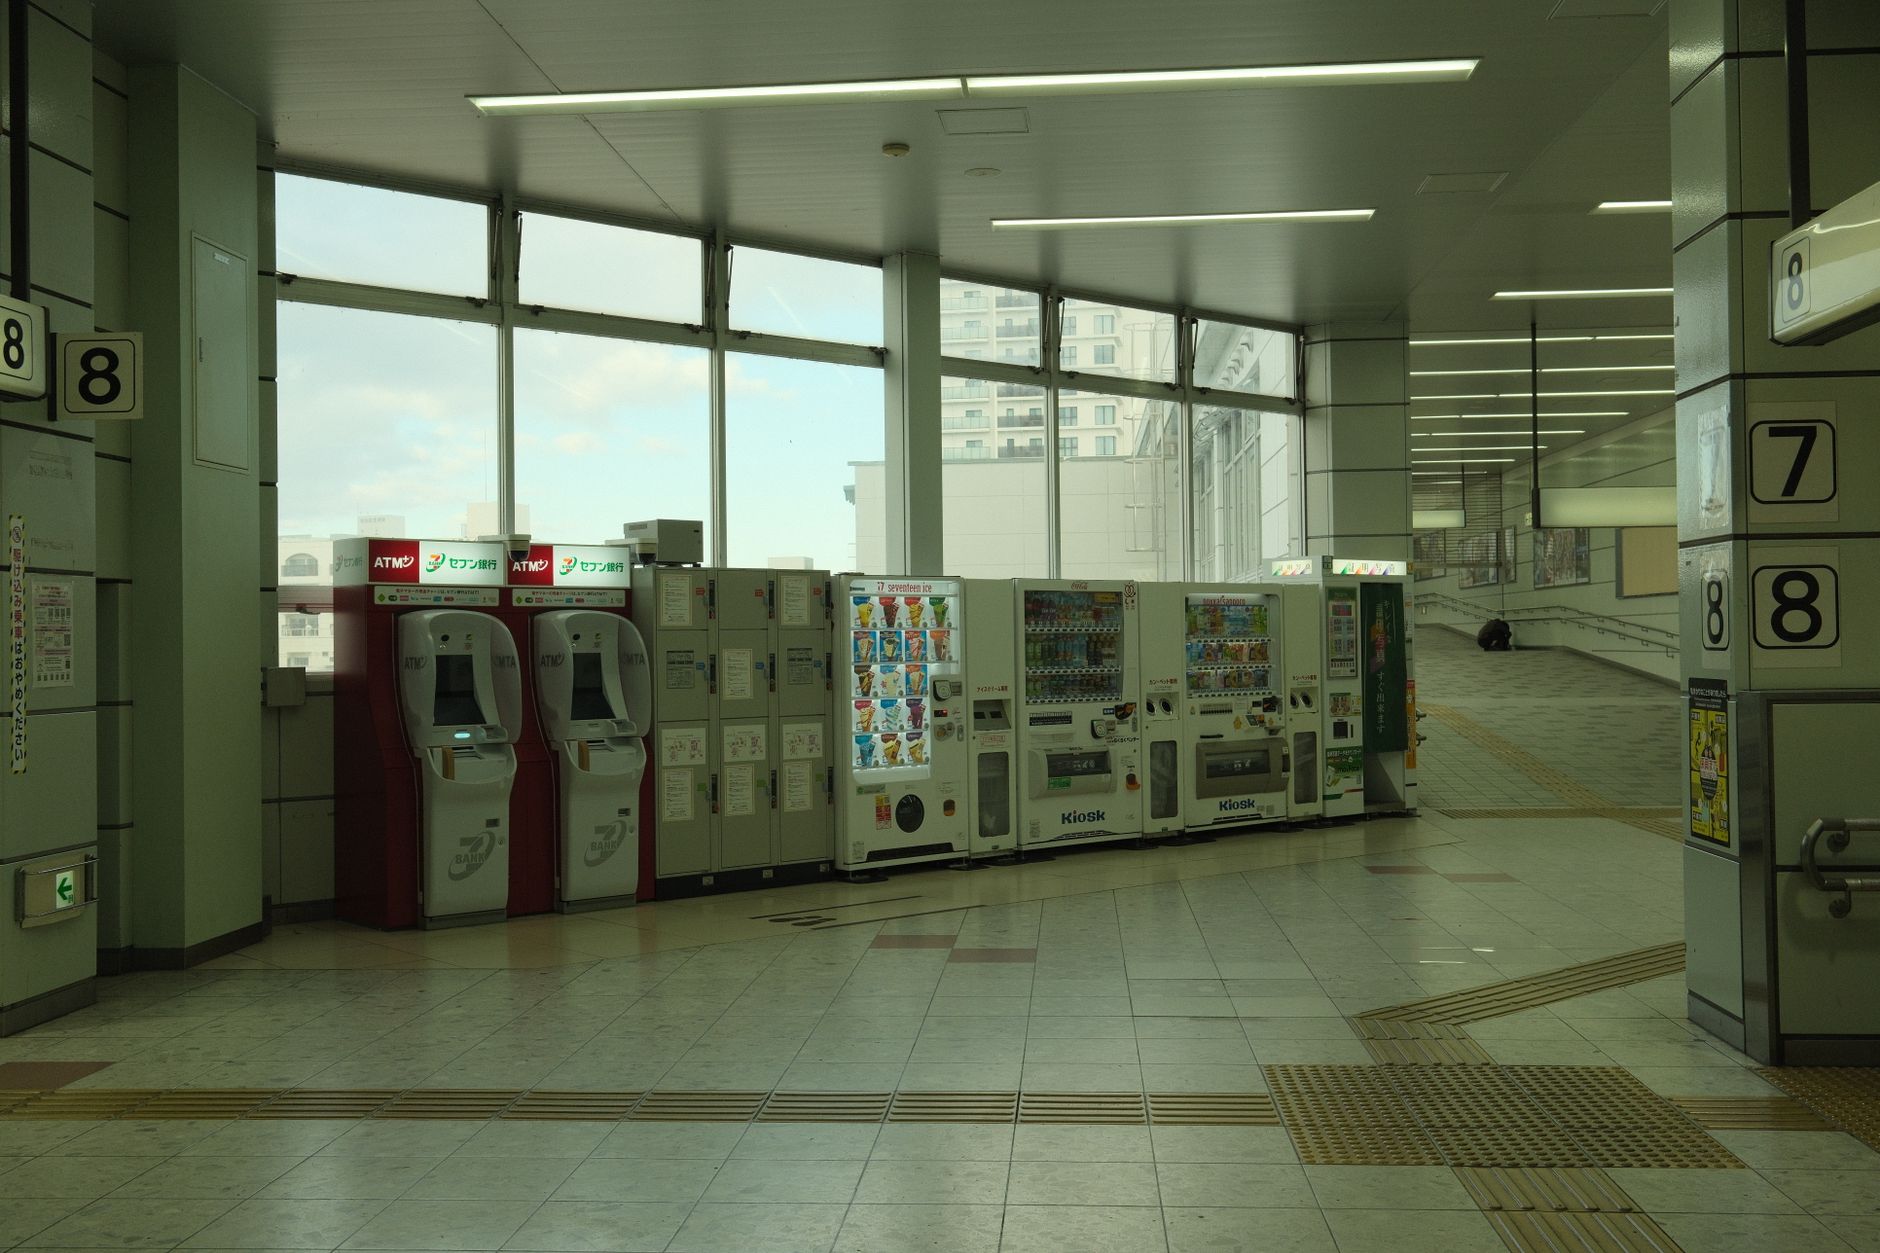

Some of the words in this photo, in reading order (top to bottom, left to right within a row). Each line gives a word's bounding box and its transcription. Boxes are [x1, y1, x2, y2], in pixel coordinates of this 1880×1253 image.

[1788, 252, 1804, 311] 8
[3, 318, 24, 370] 8
[79, 347, 121, 405] 8
[1768, 426, 1817, 497] 7
[374, 556, 404, 569] ATM
[450, 558, 497, 570] セブン銀行
[512, 560, 541, 572] ATM
[580, 561, 624, 573] セブン銀行
[1707, 580, 1724, 644] 8
[1771, 570, 1822, 643] 8
[13, 548, 23, 761] 駆け込み乗車はおやめください
[1219, 798, 1256, 812] Kiosk
[1061, 809, 1106, 825] Kiosk
[590, 839, 618, 852] BANK
[455, 852, 486, 865] BANK
